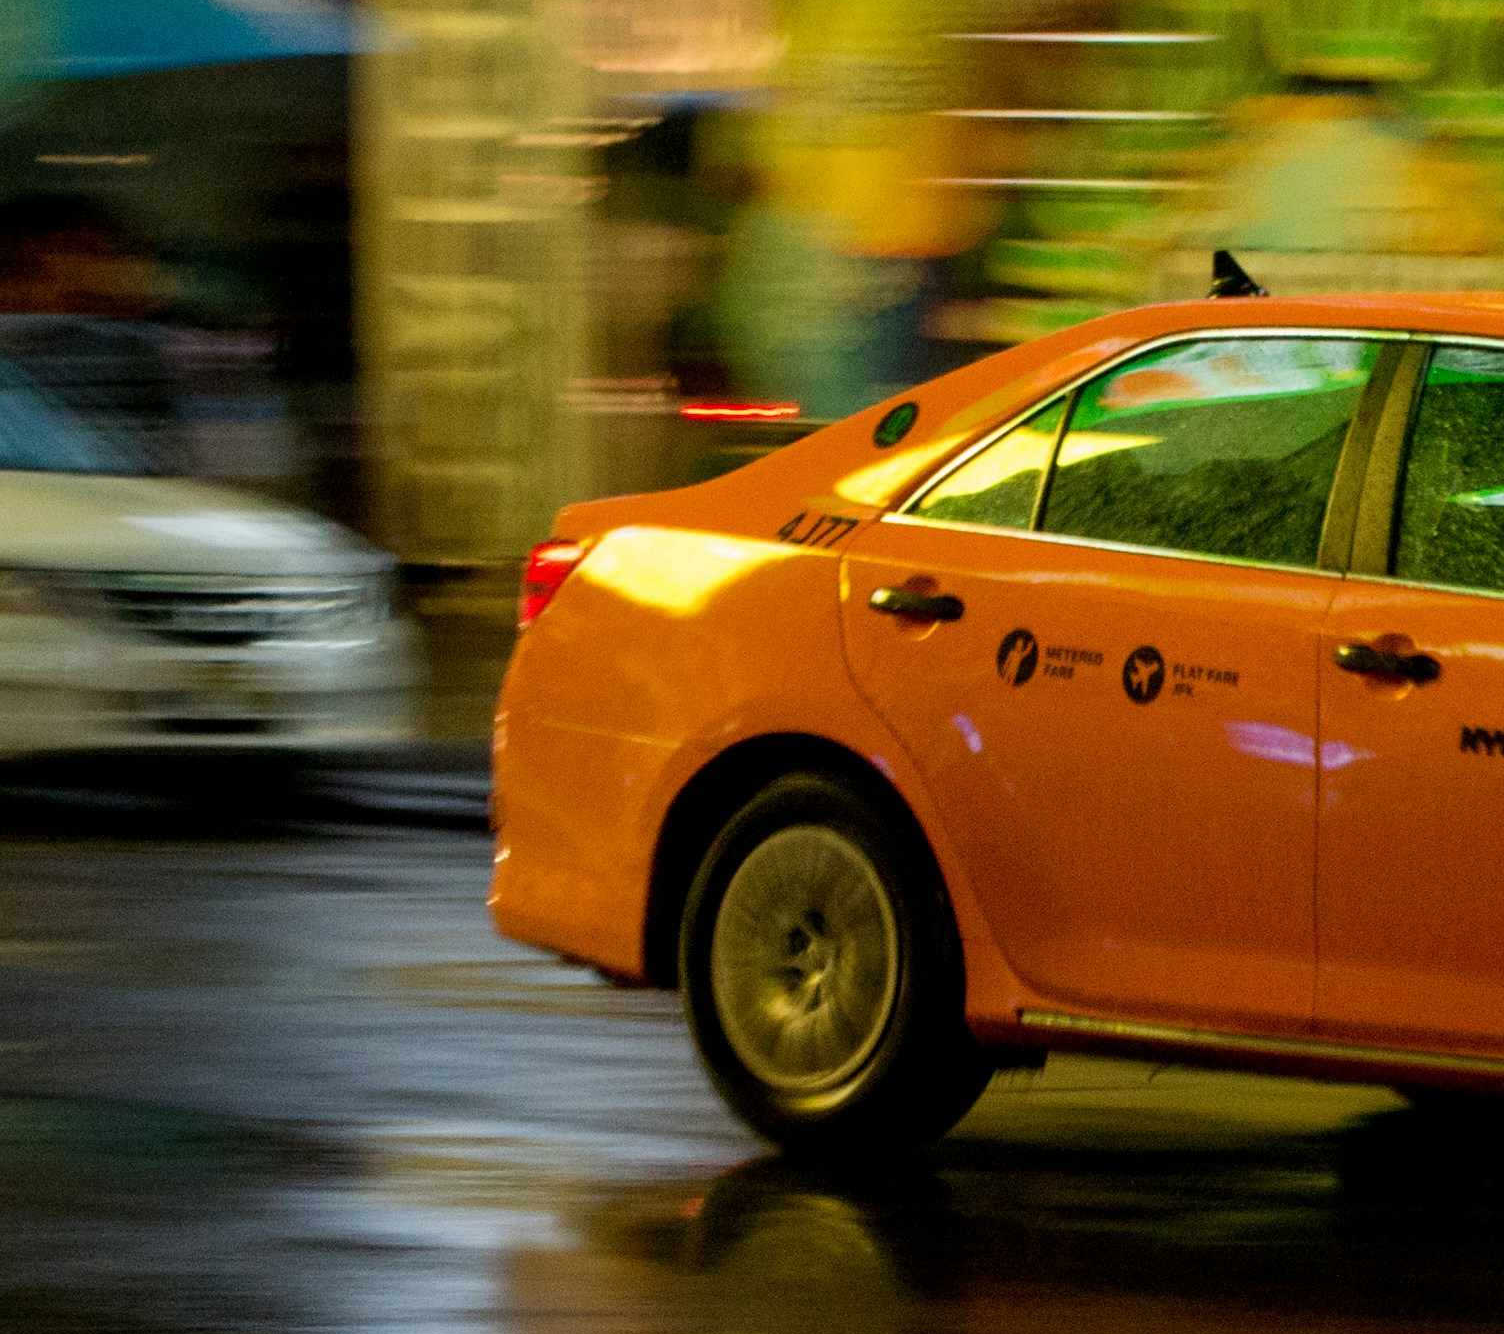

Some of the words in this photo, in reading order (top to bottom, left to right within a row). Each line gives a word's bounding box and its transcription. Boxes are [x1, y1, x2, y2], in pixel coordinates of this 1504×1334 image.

[777, 511, 858, 548] 4J77
[1045, 647, 1103, 666] METERED
[1043, 664, 1075, 679] FARE
[1172, 664, 1204, 680] FLAT
